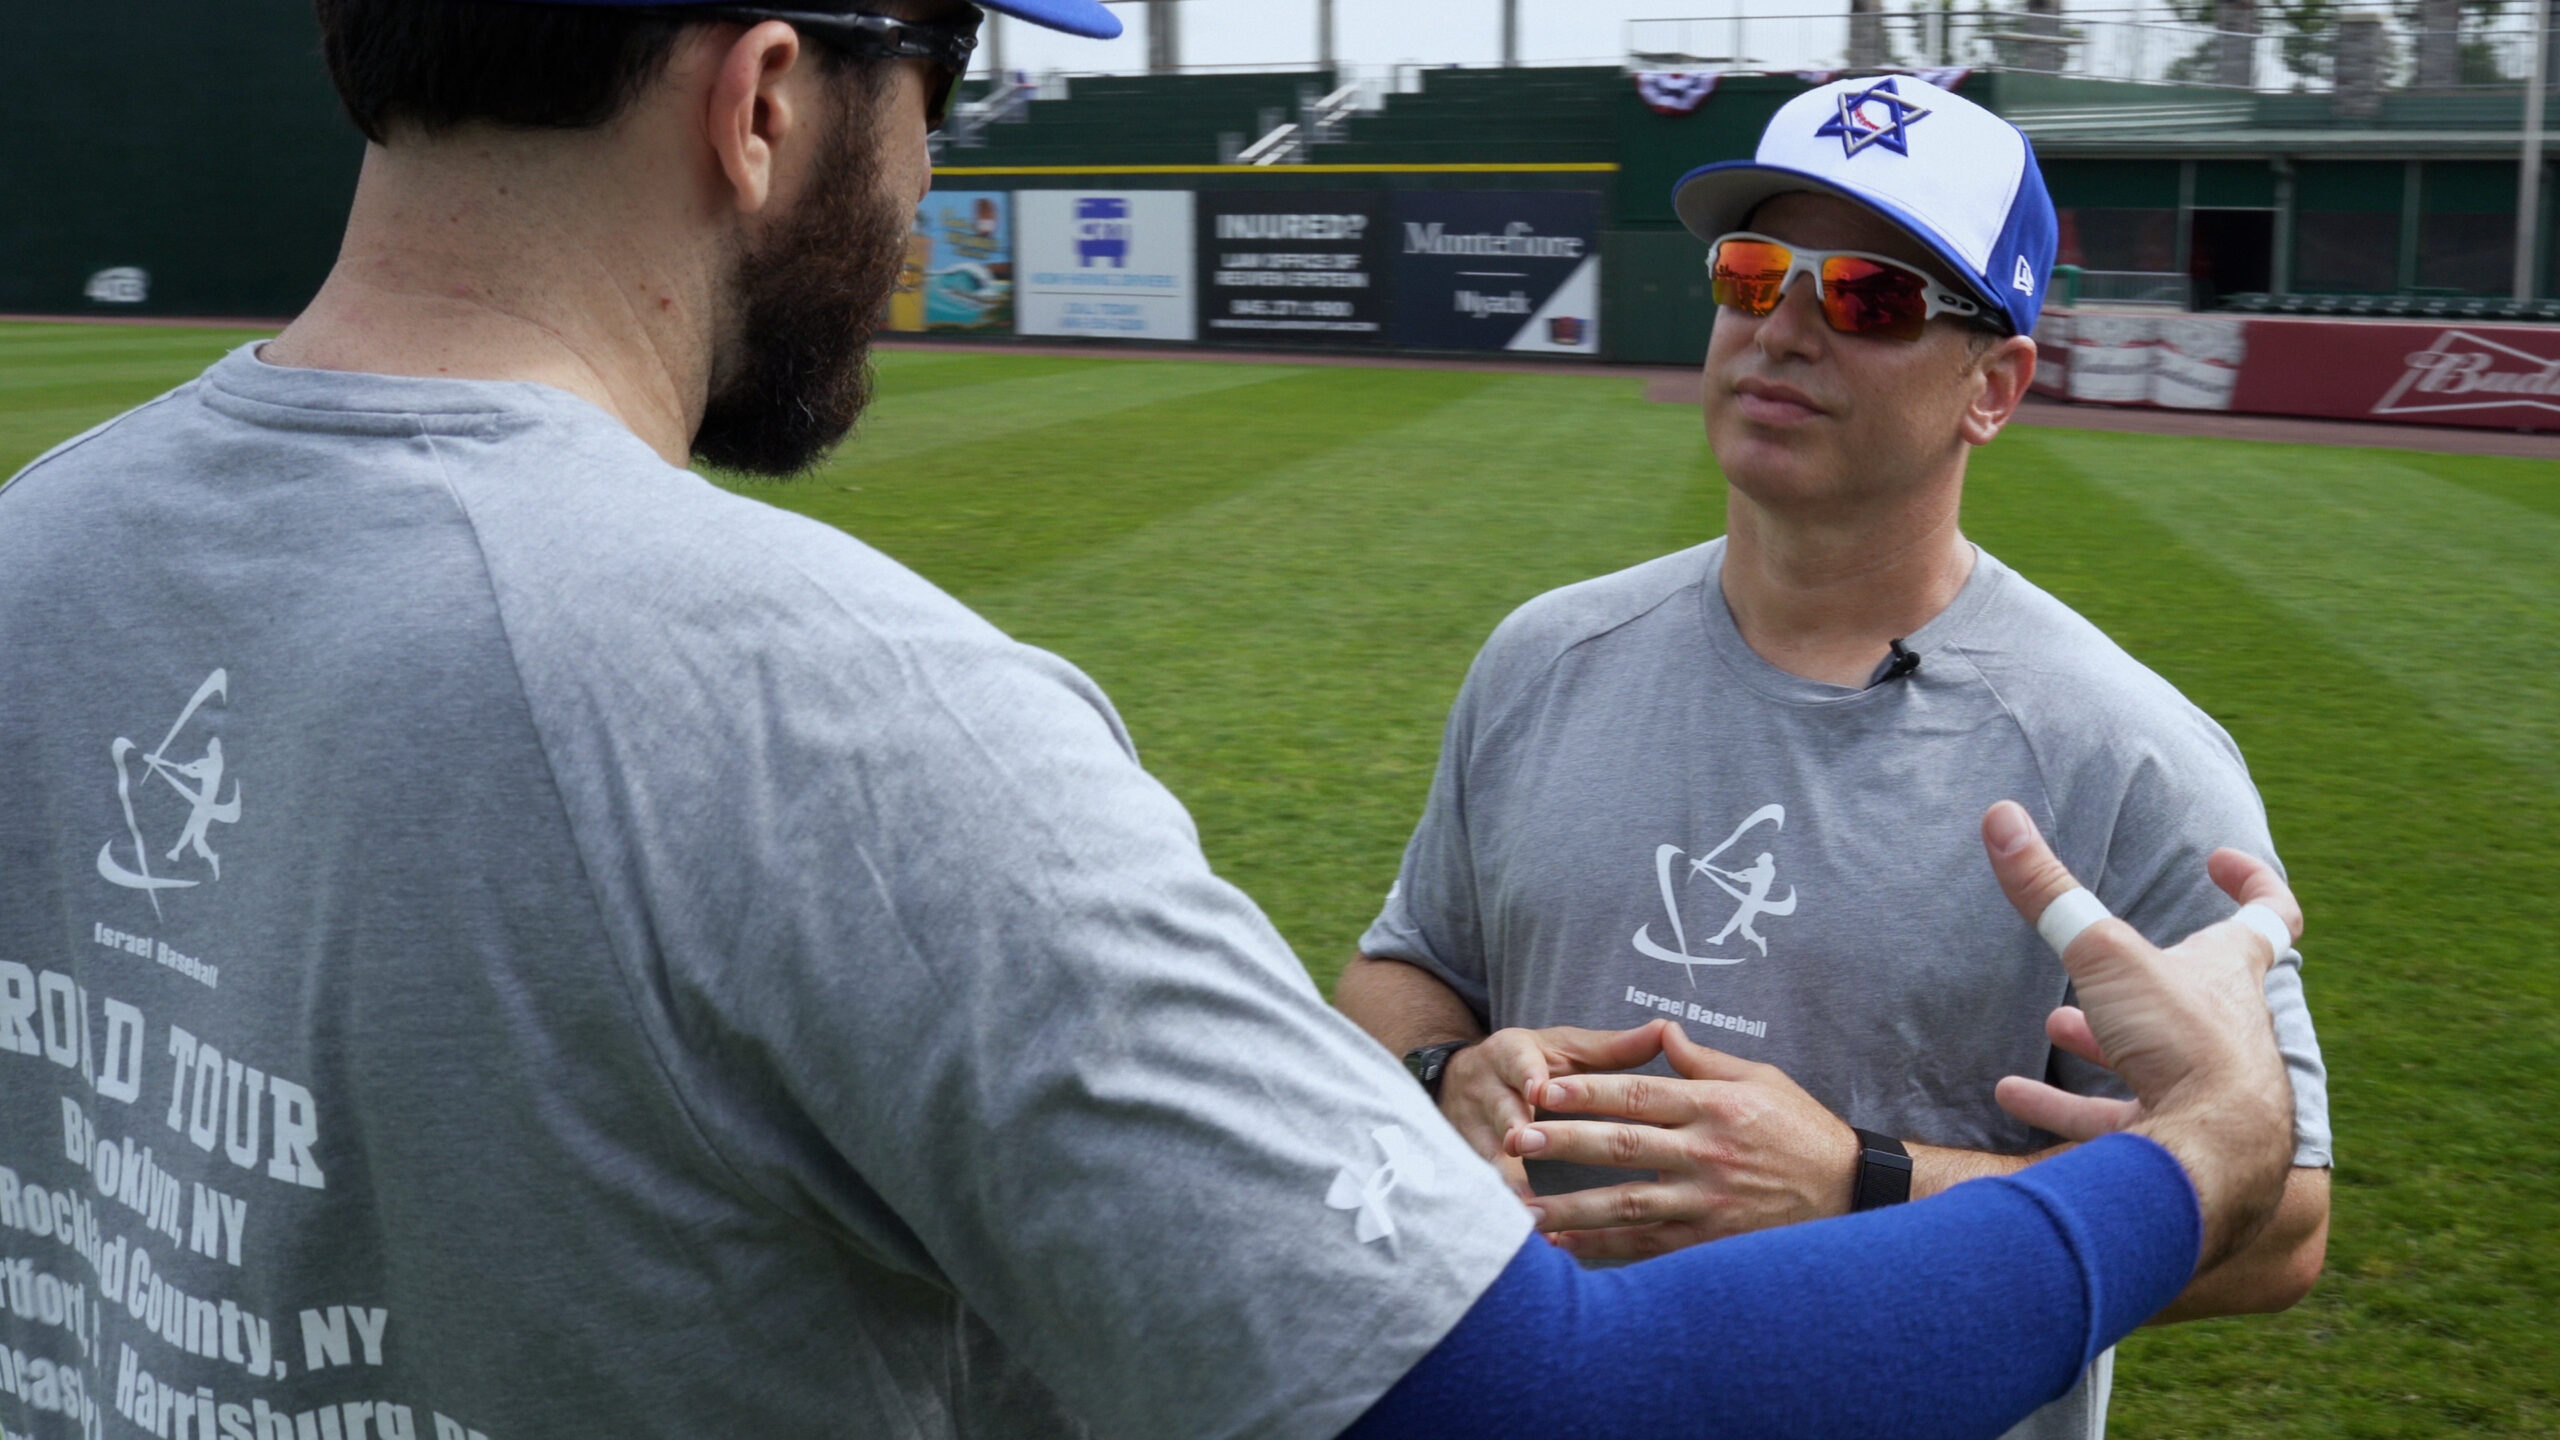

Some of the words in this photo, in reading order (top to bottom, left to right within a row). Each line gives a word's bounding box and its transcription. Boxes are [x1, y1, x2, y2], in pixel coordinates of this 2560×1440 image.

[1215, 214, 1368, 239] INJURED?
[1402, 221, 1585, 258] Montefiore
[94, 922, 153, 959] Israel
[157, 942, 219, 989] Baseball
[1625, 986, 1685, 1017] Israel
[1686, 1003, 1768, 1038] Baseball
[0, 960, 145, 1104] ROD
[166, 1024, 325, 1189] TOUR
[61, 1096, 182, 1249] Broklyn,
[190, 1182, 248, 1267] NY
[128, 1247, 287, 1381] County,
[299, 1305, 388, 1371] NY
